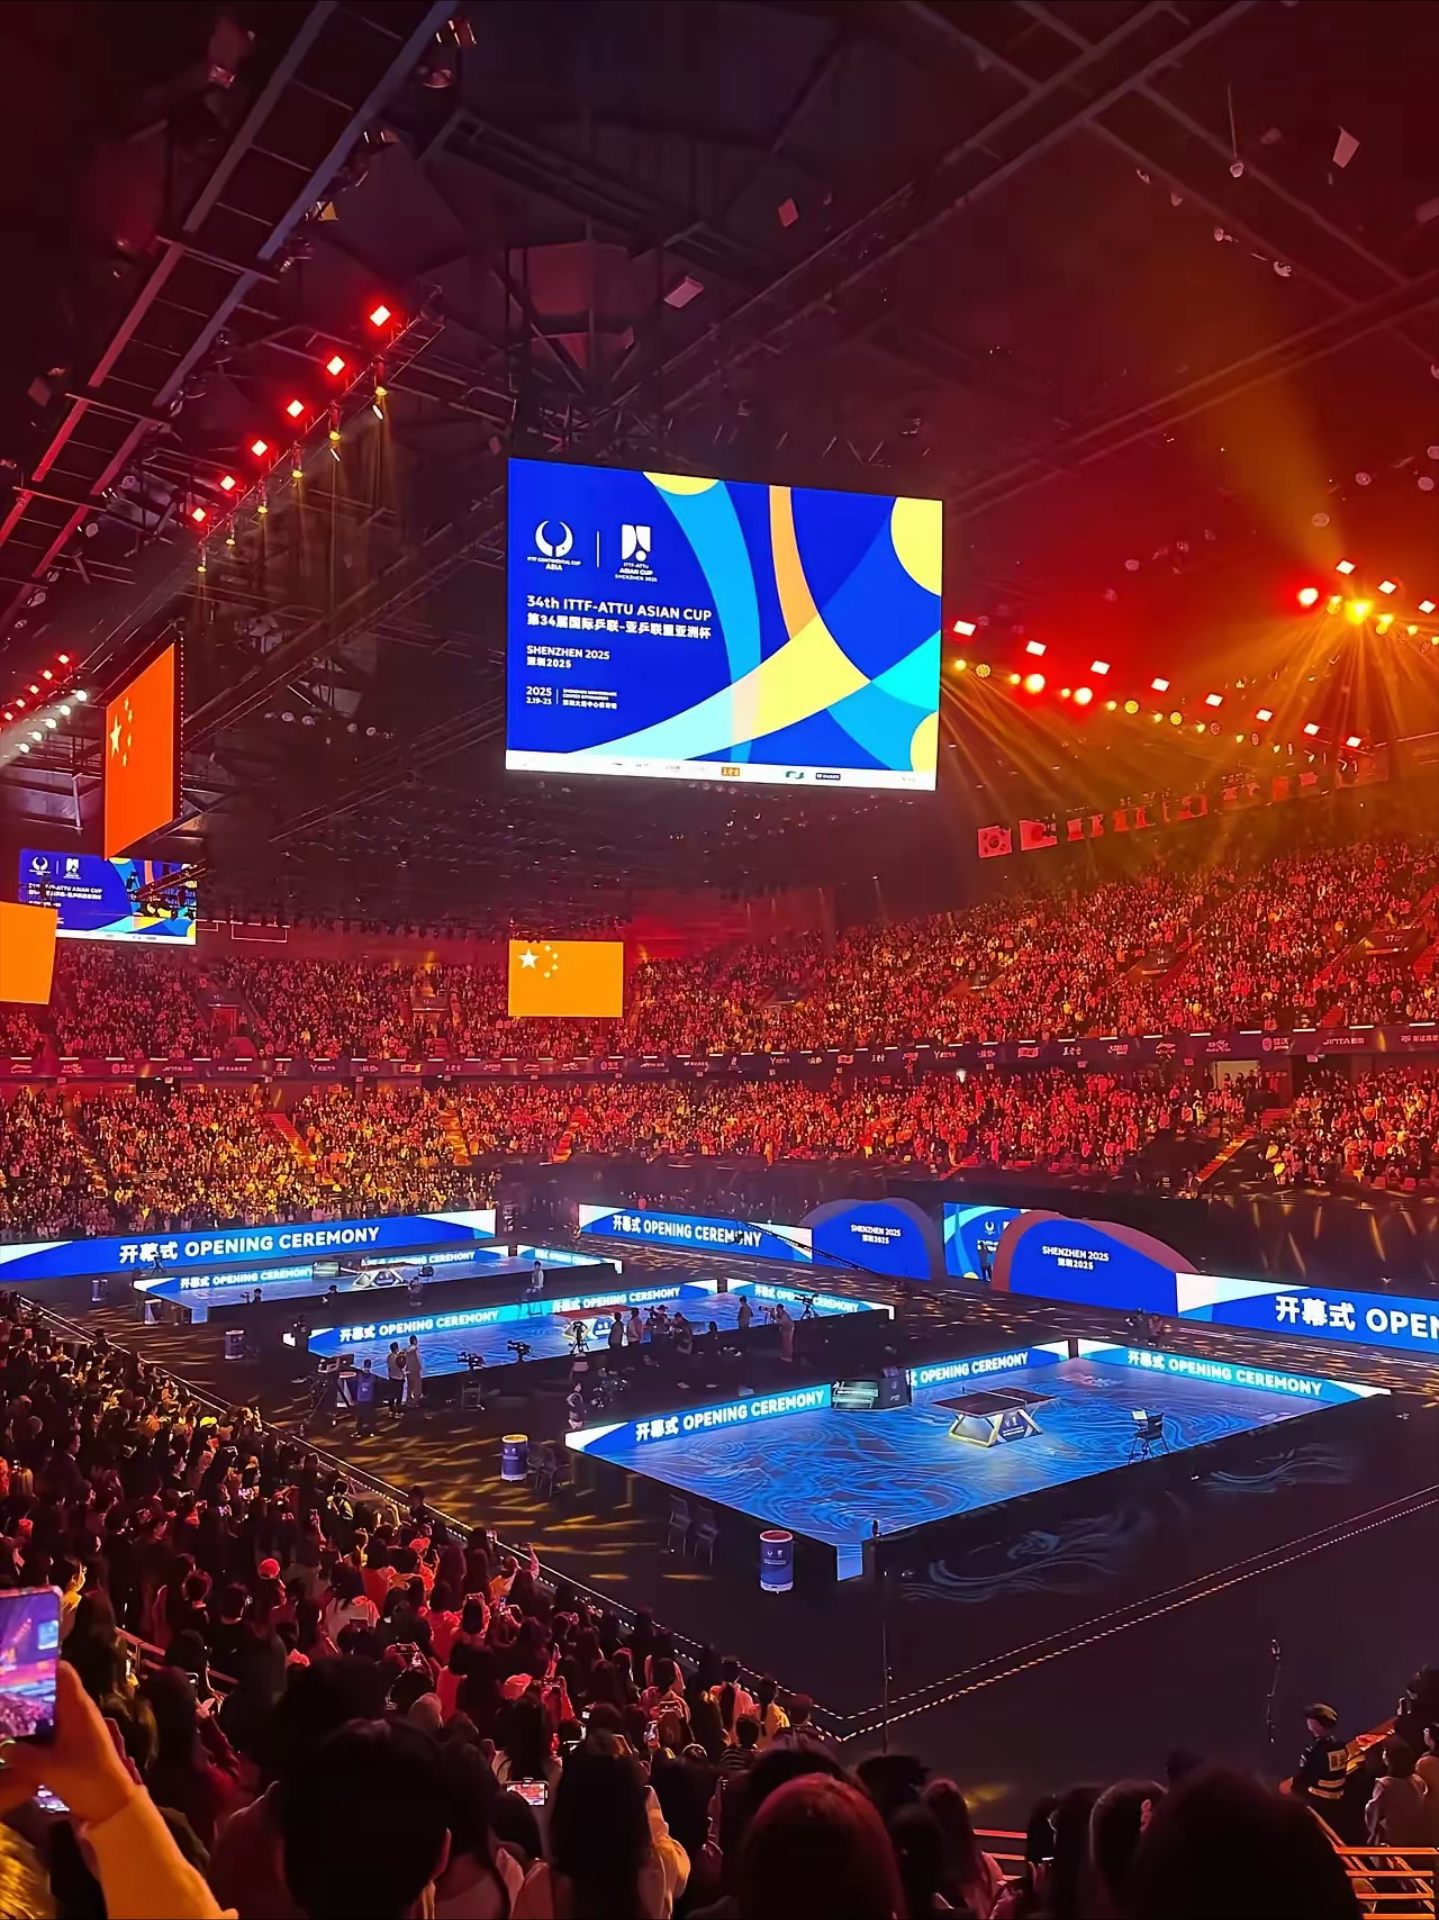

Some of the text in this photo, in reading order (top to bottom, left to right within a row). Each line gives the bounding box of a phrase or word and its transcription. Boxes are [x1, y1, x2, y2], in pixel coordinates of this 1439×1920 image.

[545, 563, 563, 571] ASIA
[526, 595, 713, 621] 34th ITTF-ATTU ASIAN CUP
[526, 645, 610, 660] SHENZHEN 2025
[526, 656, 572, 668] 深圳2025
[525, 686, 552, 696] 2025
[612, 1214, 641, 1234] 开幕式
[643, 1219, 692, 1238] OPENING
[850, 1224, 901, 1237] SHENZHEN 2025
[119, 1227, 380, 1264] 开幕式 OPENING CEREMONY
[1041, 1245, 1109, 1262] SHENZHEN 2025
[212, 1272, 259, 1286] OPENING
[629, 1286, 681, 1303] CEREMONY
[1275, 1295, 1357, 1331] 开幕式
[339, 1310, 500, 1343] 开幕式 OPENING CEREMONY
[920, 1363, 970, 1383] OPENING
[971, 1352, 1029, 1374] CEREMONY
[1128, 1350, 1323, 1396] 开幕式 OPENING CEREMONY
[635, 1390, 825, 1442] 开幕式 OPENING CEREMONY
